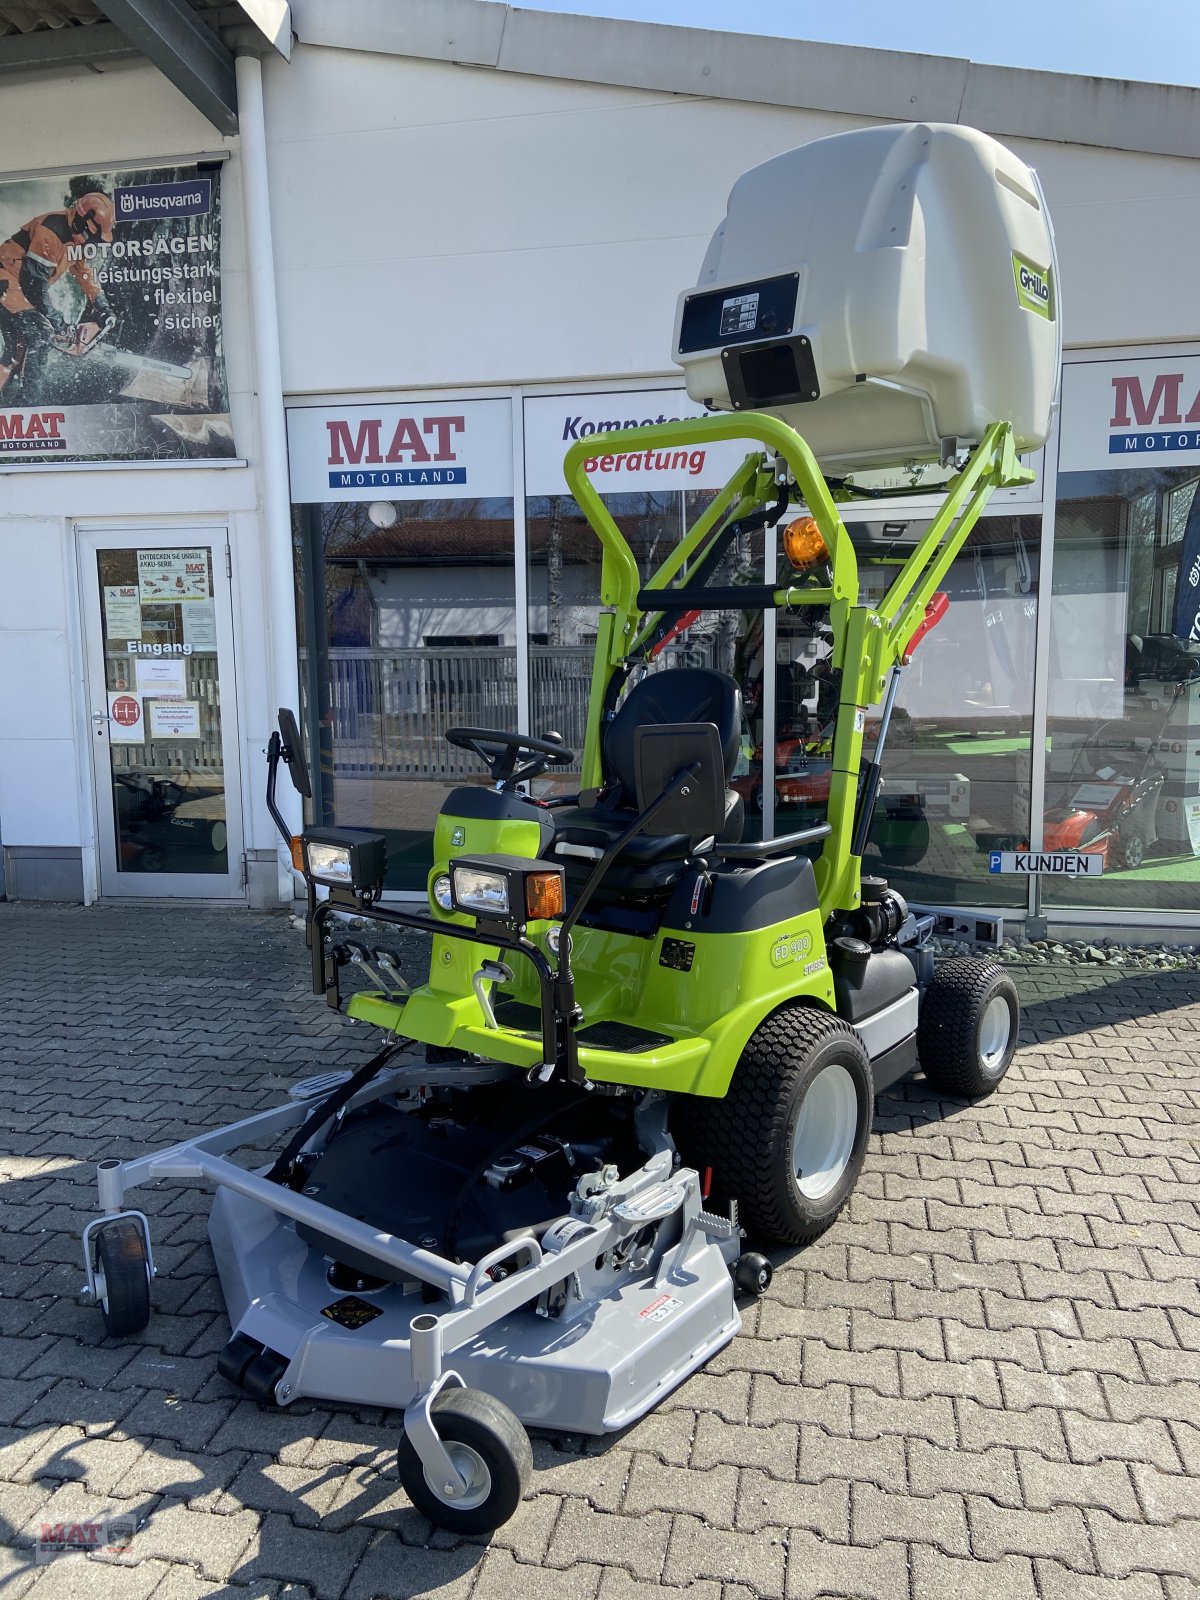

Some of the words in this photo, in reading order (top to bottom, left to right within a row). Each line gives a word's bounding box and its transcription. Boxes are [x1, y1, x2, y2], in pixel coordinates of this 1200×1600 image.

[136, 193, 201, 210] Husqvarna
[67, 234, 213, 261] MOTORSÄGEN
[93, 261, 215, 285] leistungsstark
[1020, 266, 1049, 301] Grillo
[154, 286, 217, 305] flexibel
[165, 313, 218, 330] sicher
[0, 413, 65, 439] MAT
[2, 441, 59, 449] MOTORLAND
[326, 416, 465, 465] MAT
[584, 449, 706, 475] Beratung
[341, 471, 455, 485] MOTORLAND
[127, 641, 193, 655] Eingang
[991, 856, 1000, 869] P
[1015, 854, 1089, 873] KUNDEN
[774, 944, 789, 962] FD
[790, 936, 809, 955] 900
